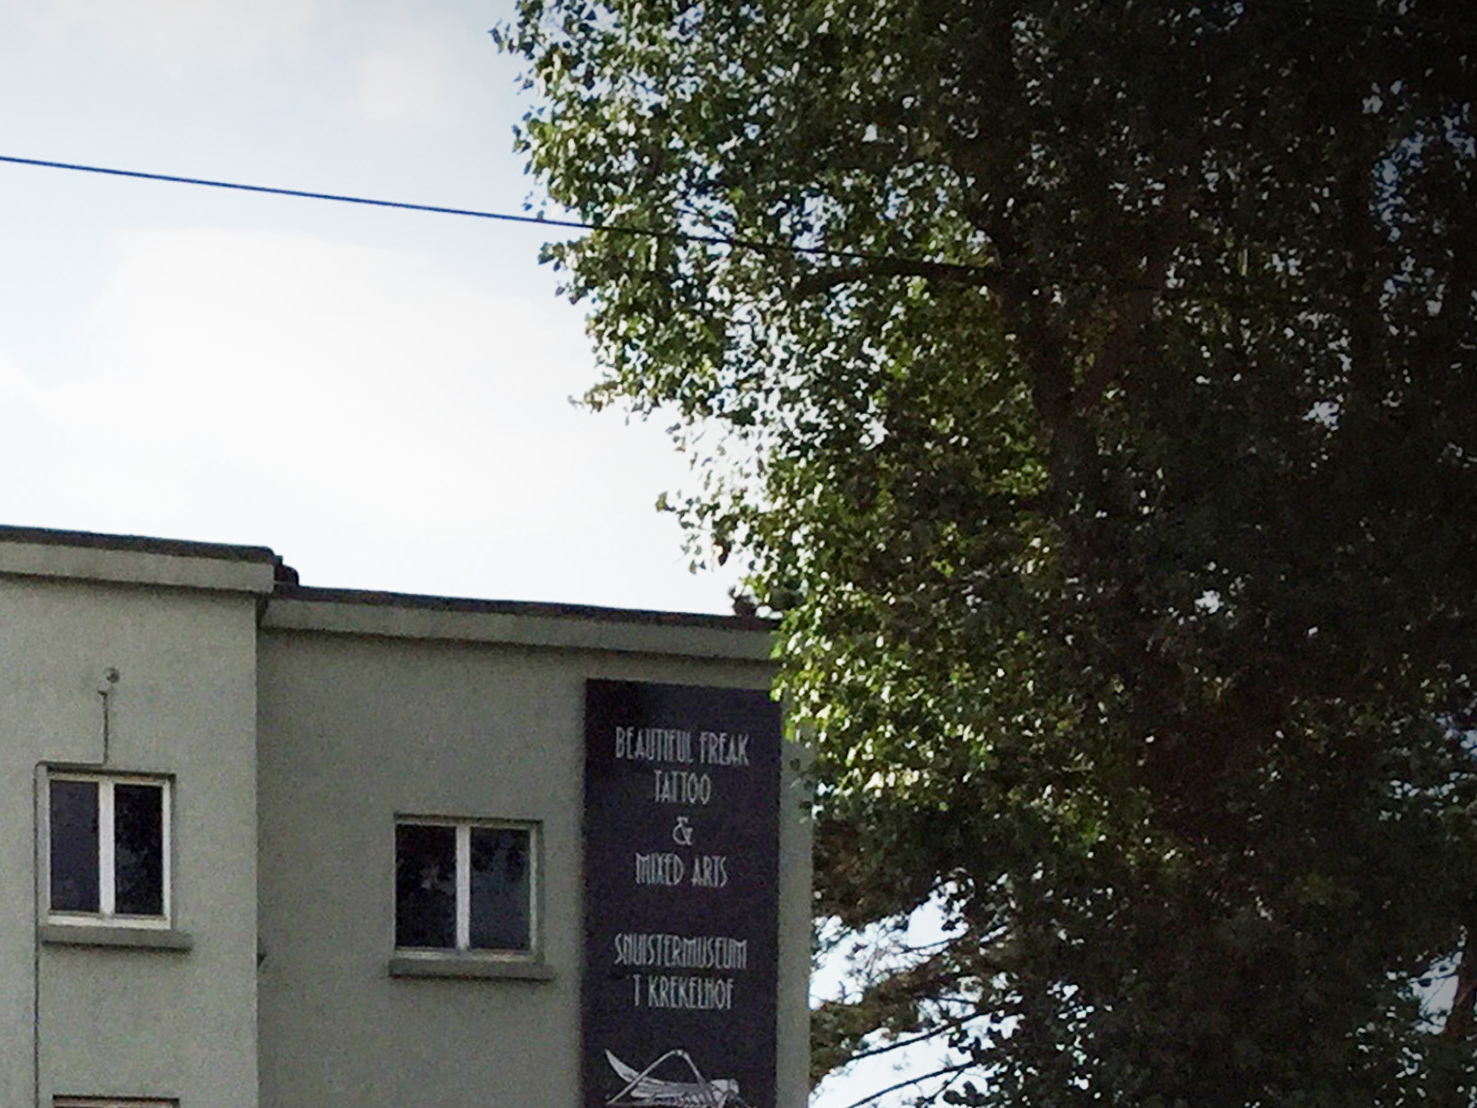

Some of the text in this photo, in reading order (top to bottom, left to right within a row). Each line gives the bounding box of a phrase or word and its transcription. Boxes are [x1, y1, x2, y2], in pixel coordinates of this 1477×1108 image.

[615, 726, 750, 767] BEAUTIFUL FREAK
[654, 769, 712, 806] TATTOO
[672, 816, 694, 846] &
[635, 852, 729, 888] MIXED ARTS
[613, 932, 747, 970] SNUISTERMUSEUM
[647, 975, 734, 1010] KREKELHOF
